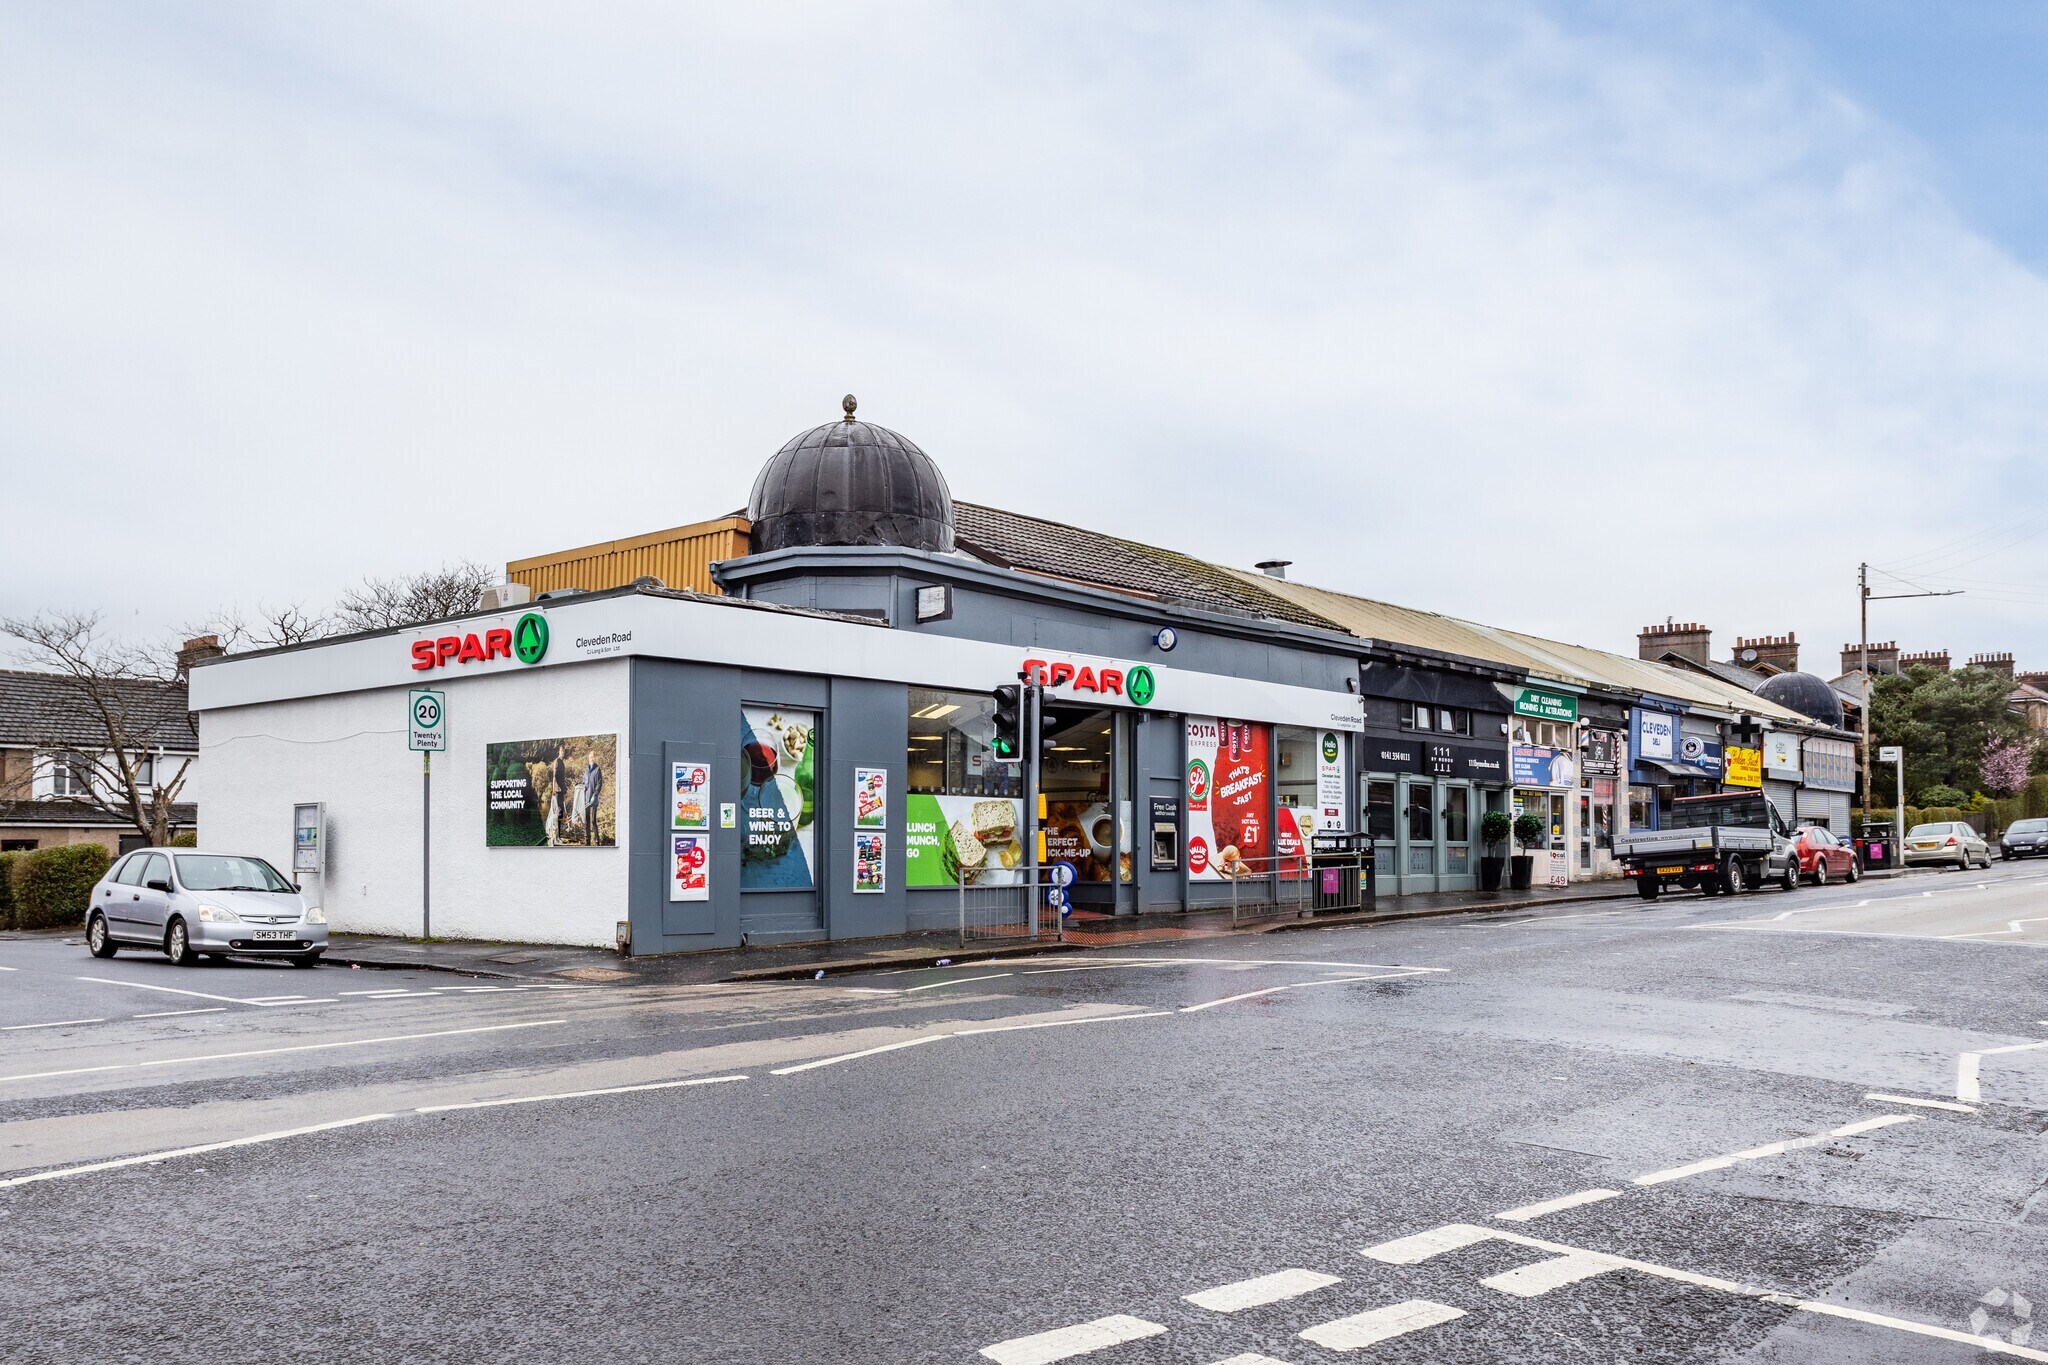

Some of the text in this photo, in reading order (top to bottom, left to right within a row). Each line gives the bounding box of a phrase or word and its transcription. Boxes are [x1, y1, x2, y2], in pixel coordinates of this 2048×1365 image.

[576, 631, 632, 649] Cleveden Road
[412, 628, 511, 671] SPAR
[1022, 659, 1124, 695] SPAR
[1531, 694, 1563, 707] DRY CLEANING
[418, 705, 437, 719] 20
[1519, 701, 1573, 718] IRONING & ALTERATIONS
[1331, 713, 1362, 724] Cleveden Road
[1642, 721, 1671, 736] CLEVEDEN
[413, 732, 441, 743] Twenty's
[1652, 738, 1660, 746] DELI
[417, 740, 438, 748] Plenty
[1325, 740, 1336, 749] Hello
[1433, 746, 1450, 757] 111
[694, 775, 704, 783] £5
[1228, 766, 1249, 781] THAT'S
[491, 779, 527, 789] SUPPORTING
[1220, 772, 1262, 798] BREAKFAST
[491, 789, 523, 799] THE LOCAL
[1237, 791, 1252, 805] FAST
[491, 801, 526, 809] COMMUNITY
[749, 808, 786, 819] BEER &
[749, 821, 791, 832] WINE TO
[906, 822, 936, 833] LUNCH
[749, 834, 782, 845] ENJOY
[907, 834, 940, 847] MUNCH,
[1047, 837, 1078, 846] ERFECT
[1287, 838, 1301, 846] DEALS
[691, 850, 702, 861] £4
[907, 848, 919, 858] GO
[1047, 849, 1091, 858] ICK-ME-UP
[1189, 846, 1206, 855] VALUE
[1550, 851, 1566, 859] local
[1550, 875, 1566, 885] £49
[256, 931, 294, 940] SM53 THF
